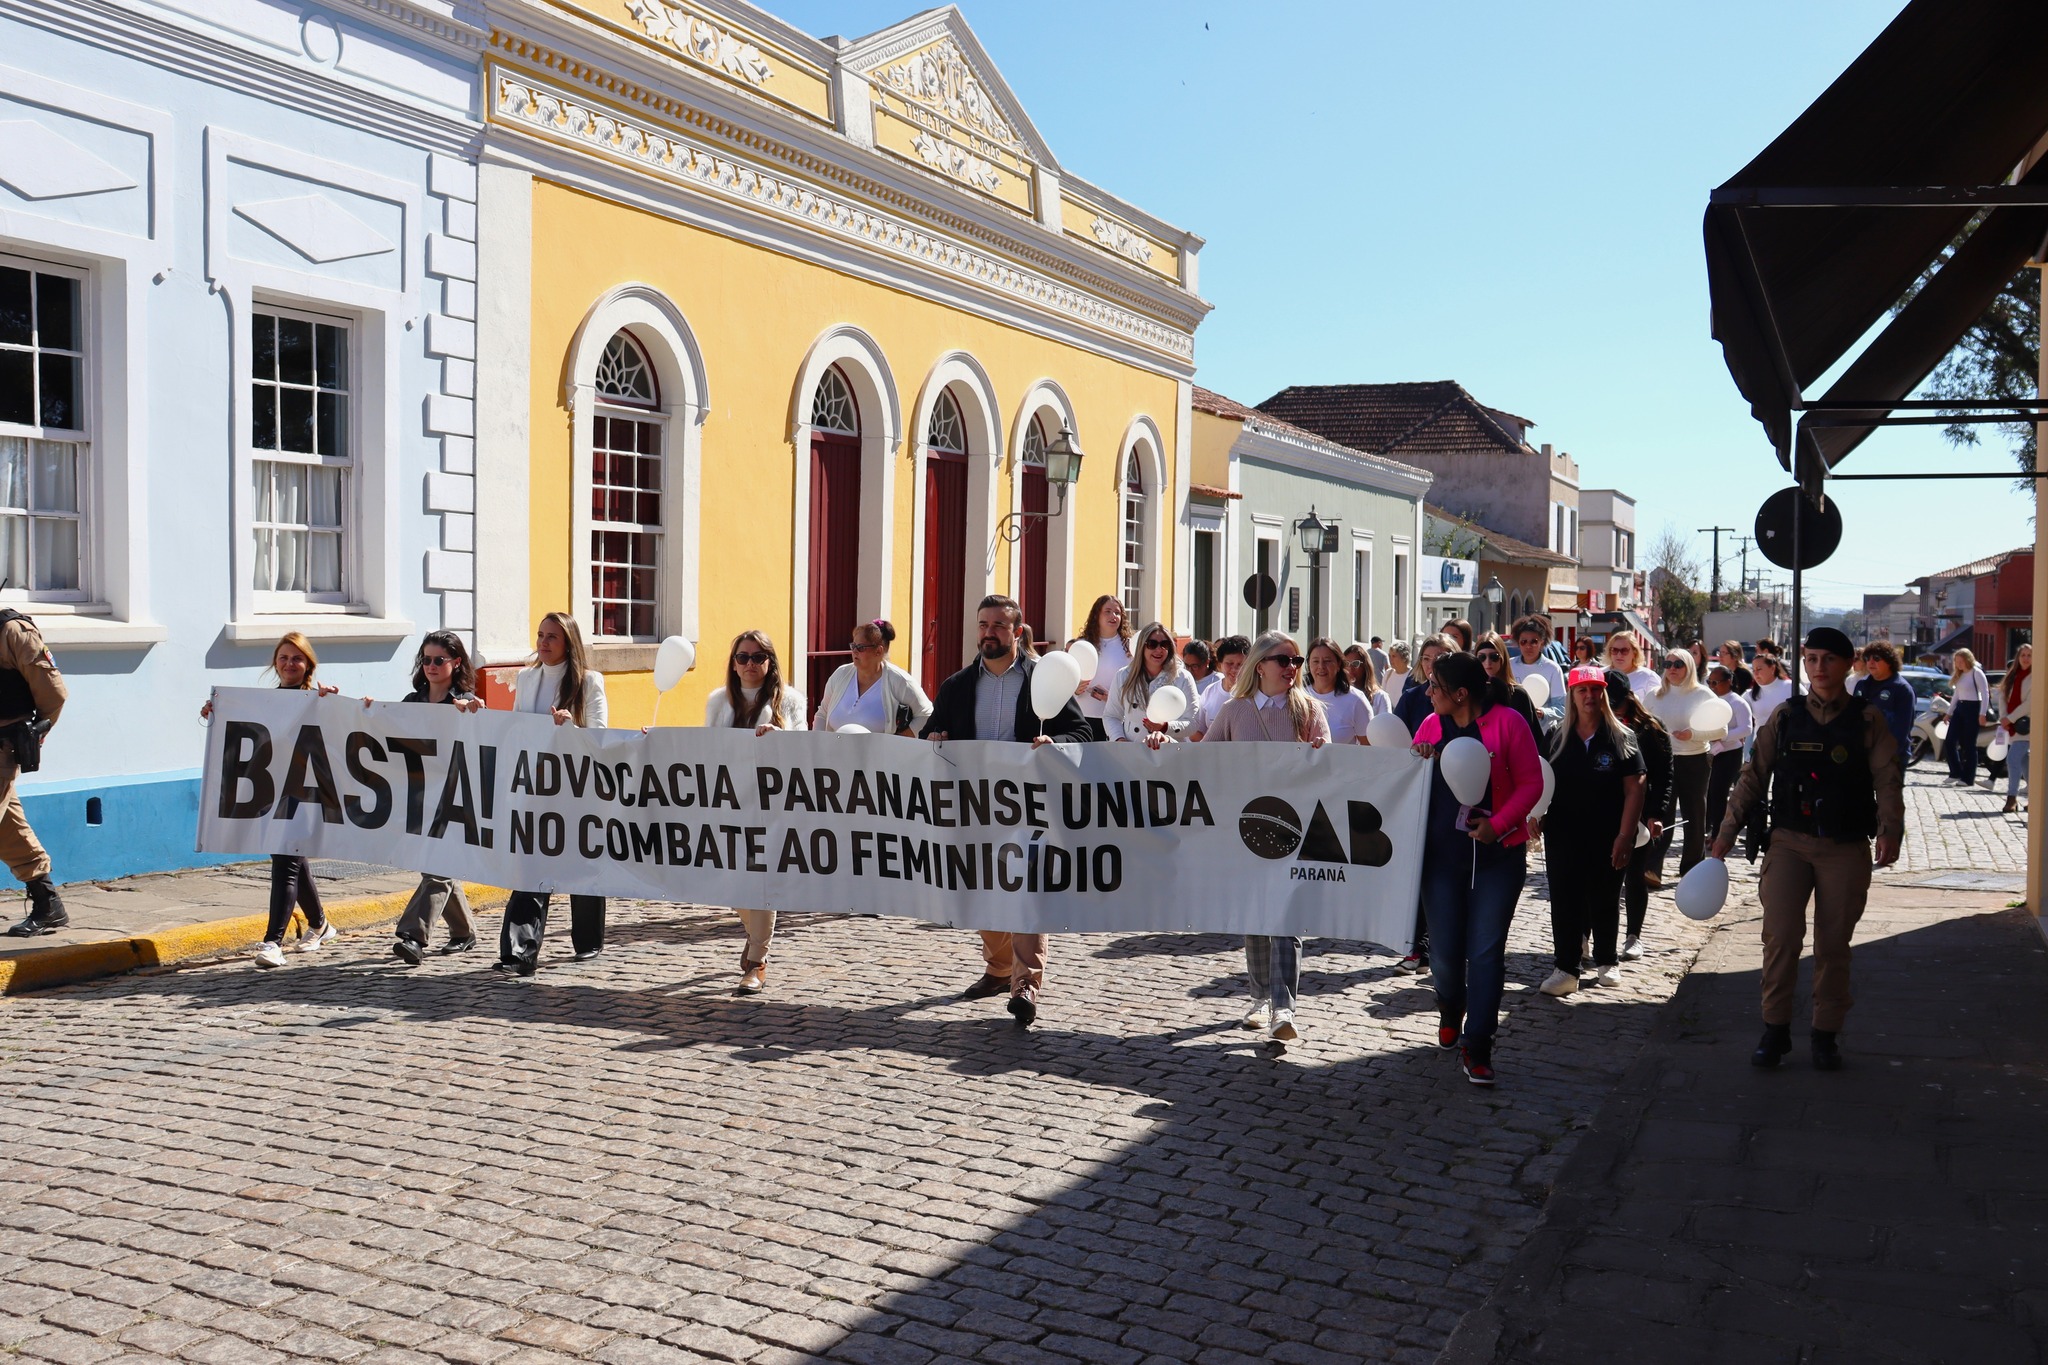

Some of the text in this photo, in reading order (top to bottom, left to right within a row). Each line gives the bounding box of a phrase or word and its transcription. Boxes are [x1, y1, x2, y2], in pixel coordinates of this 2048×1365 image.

[905, 102, 952, 136] THEATRO
[218, 720, 497, 849] BASTA!
[510, 749, 1215, 829] ADVOCACIA PARANAENSE UNIDA
[509, 809, 1122, 893] NO COMBATE AO FEMINICÍDIO
[1239, 795, 1393, 867] OAB
[1290, 866, 1346, 883] PARANÁ
